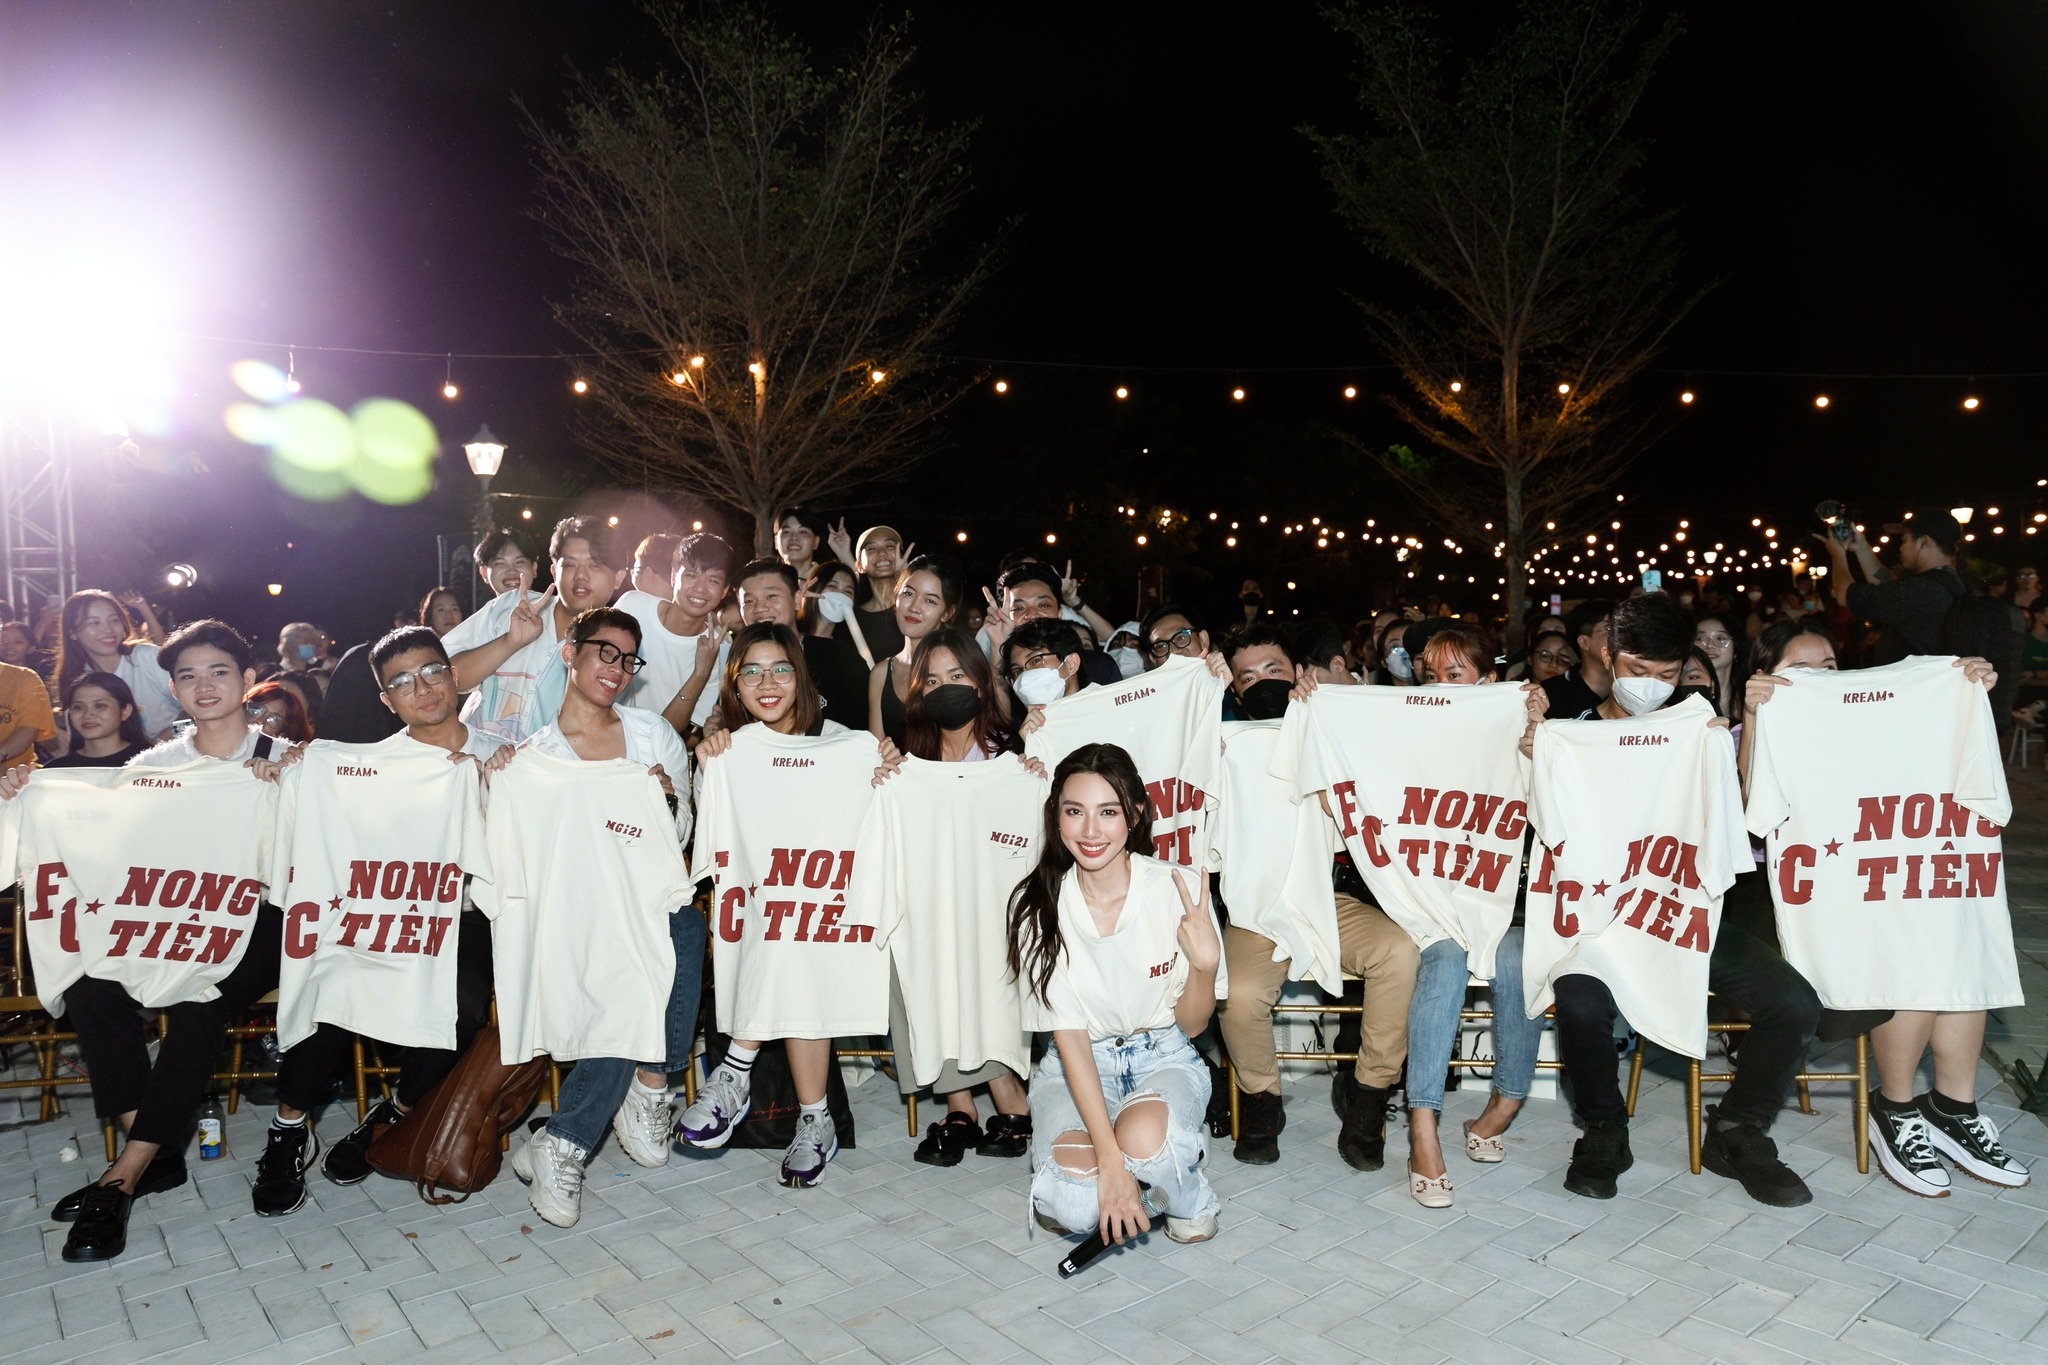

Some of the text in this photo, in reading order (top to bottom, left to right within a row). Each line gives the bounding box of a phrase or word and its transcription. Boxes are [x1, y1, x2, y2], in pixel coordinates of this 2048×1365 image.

[1114, 688, 1150, 706] KREAM
[1405, 695, 1445, 706] KREAM
[1843, 691, 1887, 704] KREAM
[1619, 735, 1662, 746] KREAM
[337, 766, 372, 777] KREAM
[772, 757, 809, 768] KREAM
[132, 778, 175, 789] KREAM
[1398, 786, 1527, 840] NONG
[1857, 841, 2001, 902] TIÊN
[347, 860, 462, 904] NONG
[115, 866, 260, 917] NONG
[106, 913, 244, 964] TIÊN
[336, 904, 452, 957] TIÊN
